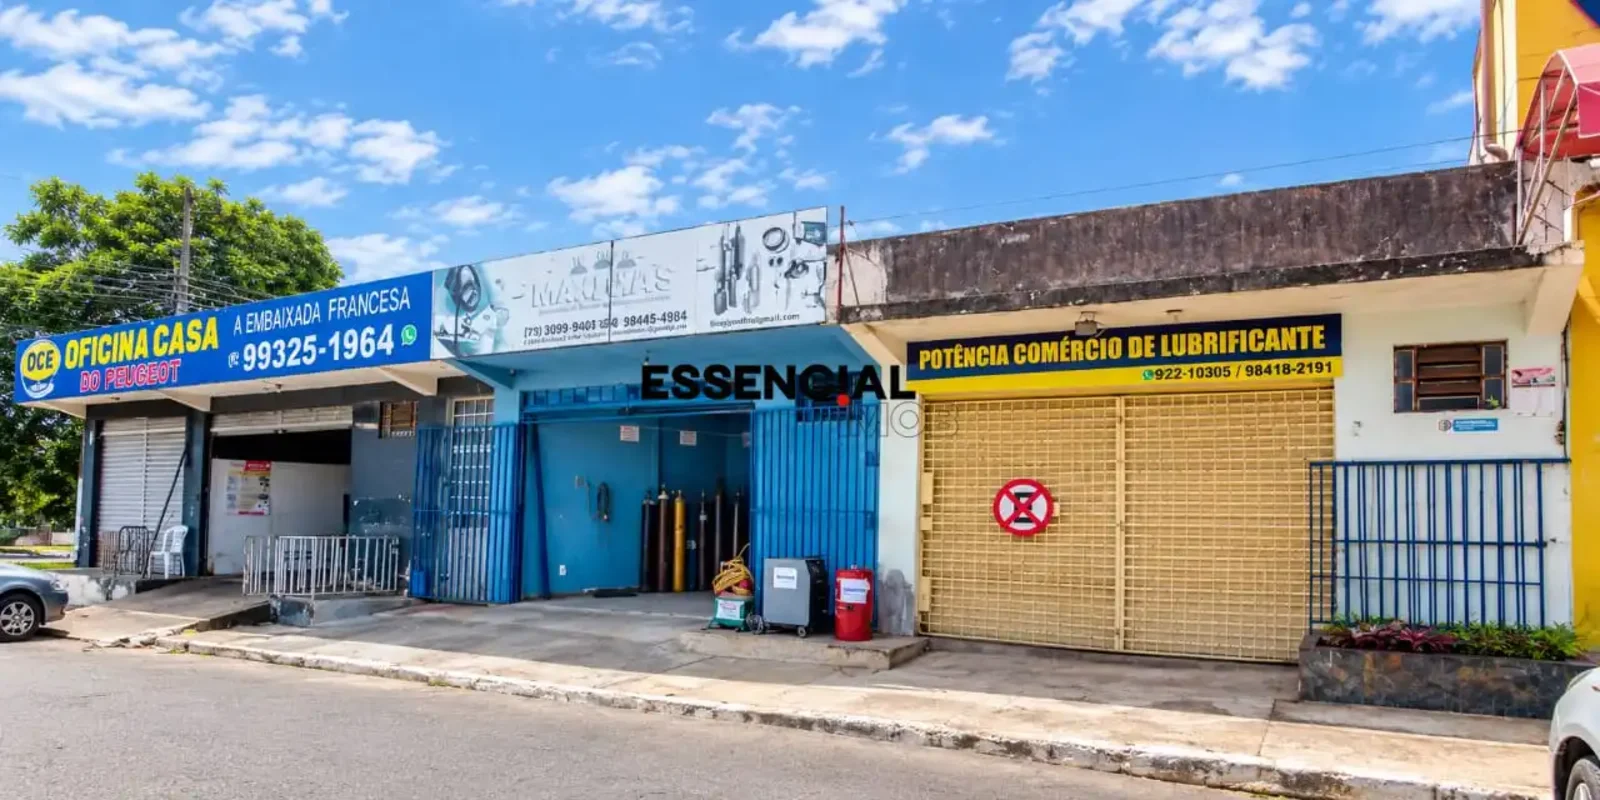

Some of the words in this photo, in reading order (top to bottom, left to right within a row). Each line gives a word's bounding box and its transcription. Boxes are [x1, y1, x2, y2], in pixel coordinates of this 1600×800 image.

[233, 315, 242, 336] A
[245, 301, 321, 334] EMBAIXADA
[328, 285, 411, 321] FRANCESA
[623, 310, 688, 328] 98445-4984
[64, 327, 149, 370] OFICINA
[153, 316, 219, 357] CASA
[243, 323, 395, 372] 99325-1964
[919, 343, 1010, 371] POTÊNCIA
[1013, 335, 1122, 366] COMÉRCIO
[1127, 335, 1156, 359] DE
[1160, 324, 1326, 358] LUBRIFICANTE
[80, 369, 101, 393] DO
[105, 358, 182, 391] PEUGEOT
[1155, 365, 1231, 380] 922-10305
[1245, 361, 1333, 377] 98418-2191
